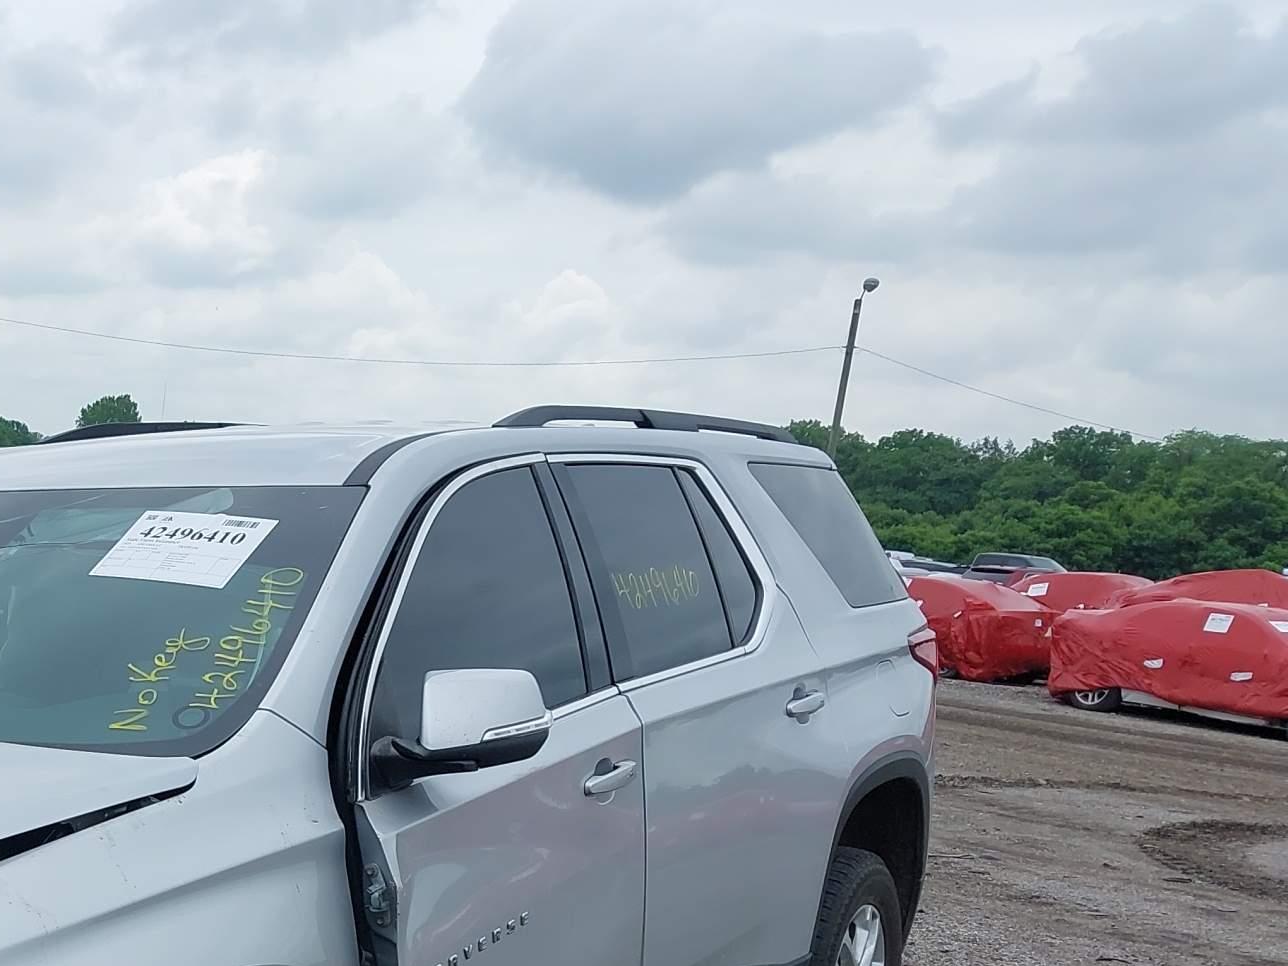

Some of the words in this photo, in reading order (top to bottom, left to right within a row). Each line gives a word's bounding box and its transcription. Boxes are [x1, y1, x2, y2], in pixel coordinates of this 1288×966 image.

[140, 525, 247, 546] 42496410
[189, 567, 304, 709] 42496410
[109, 688, 158, 731] No
